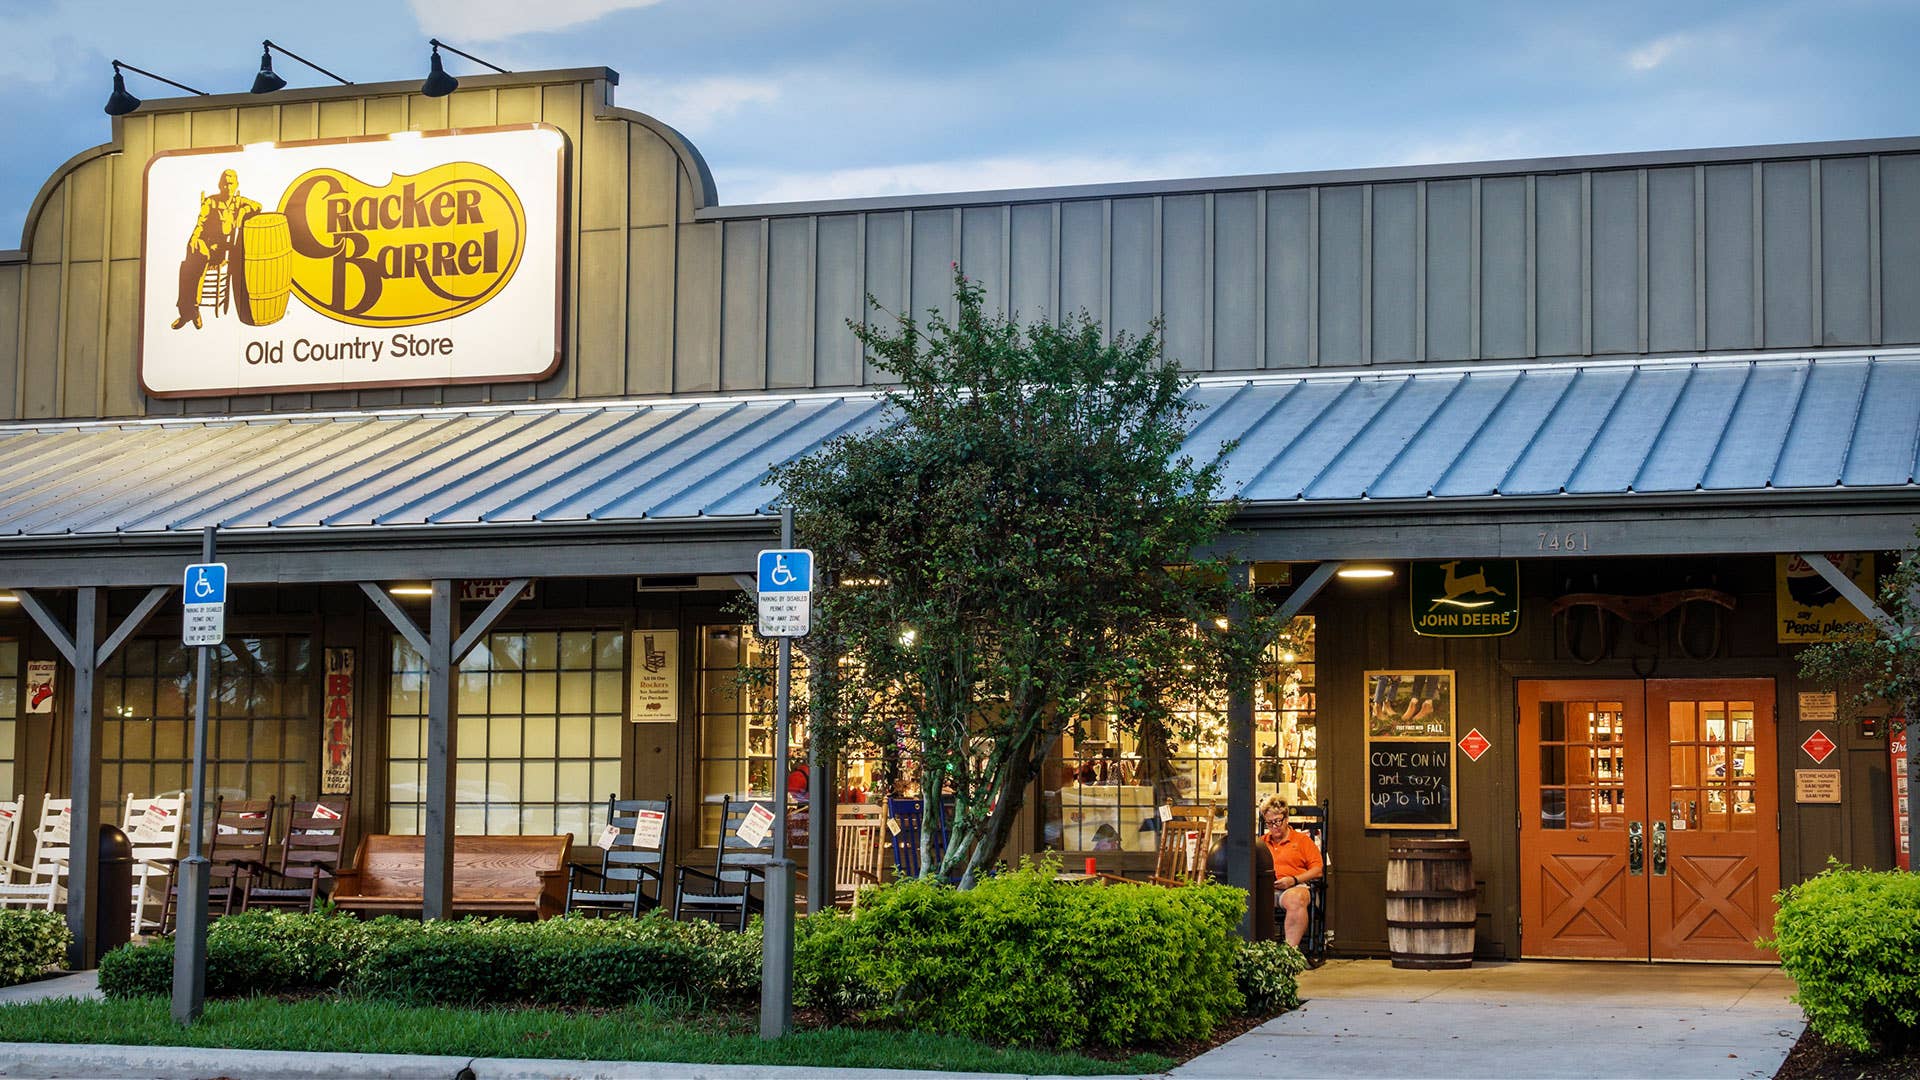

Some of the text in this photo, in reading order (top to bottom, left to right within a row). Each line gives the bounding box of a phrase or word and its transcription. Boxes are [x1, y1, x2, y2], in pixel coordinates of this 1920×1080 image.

[284, 174, 484, 259] Cracker
[331, 230, 499, 316] Barrel
[245, 333, 454, 365] Old Country Store
[1537, 530, 1589, 551] 7461
[1419, 614, 1510, 626] JOHN DEERE
[328, 674, 351, 768] BAIT
[1427, 724, 1444, 733] FALL
[1371, 752, 1408, 768] COME
[1411, 752, 1428, 768] ON
[1378, 772, 1441, 790] and cozy
[1415, 790, 1441, 806] Fall
